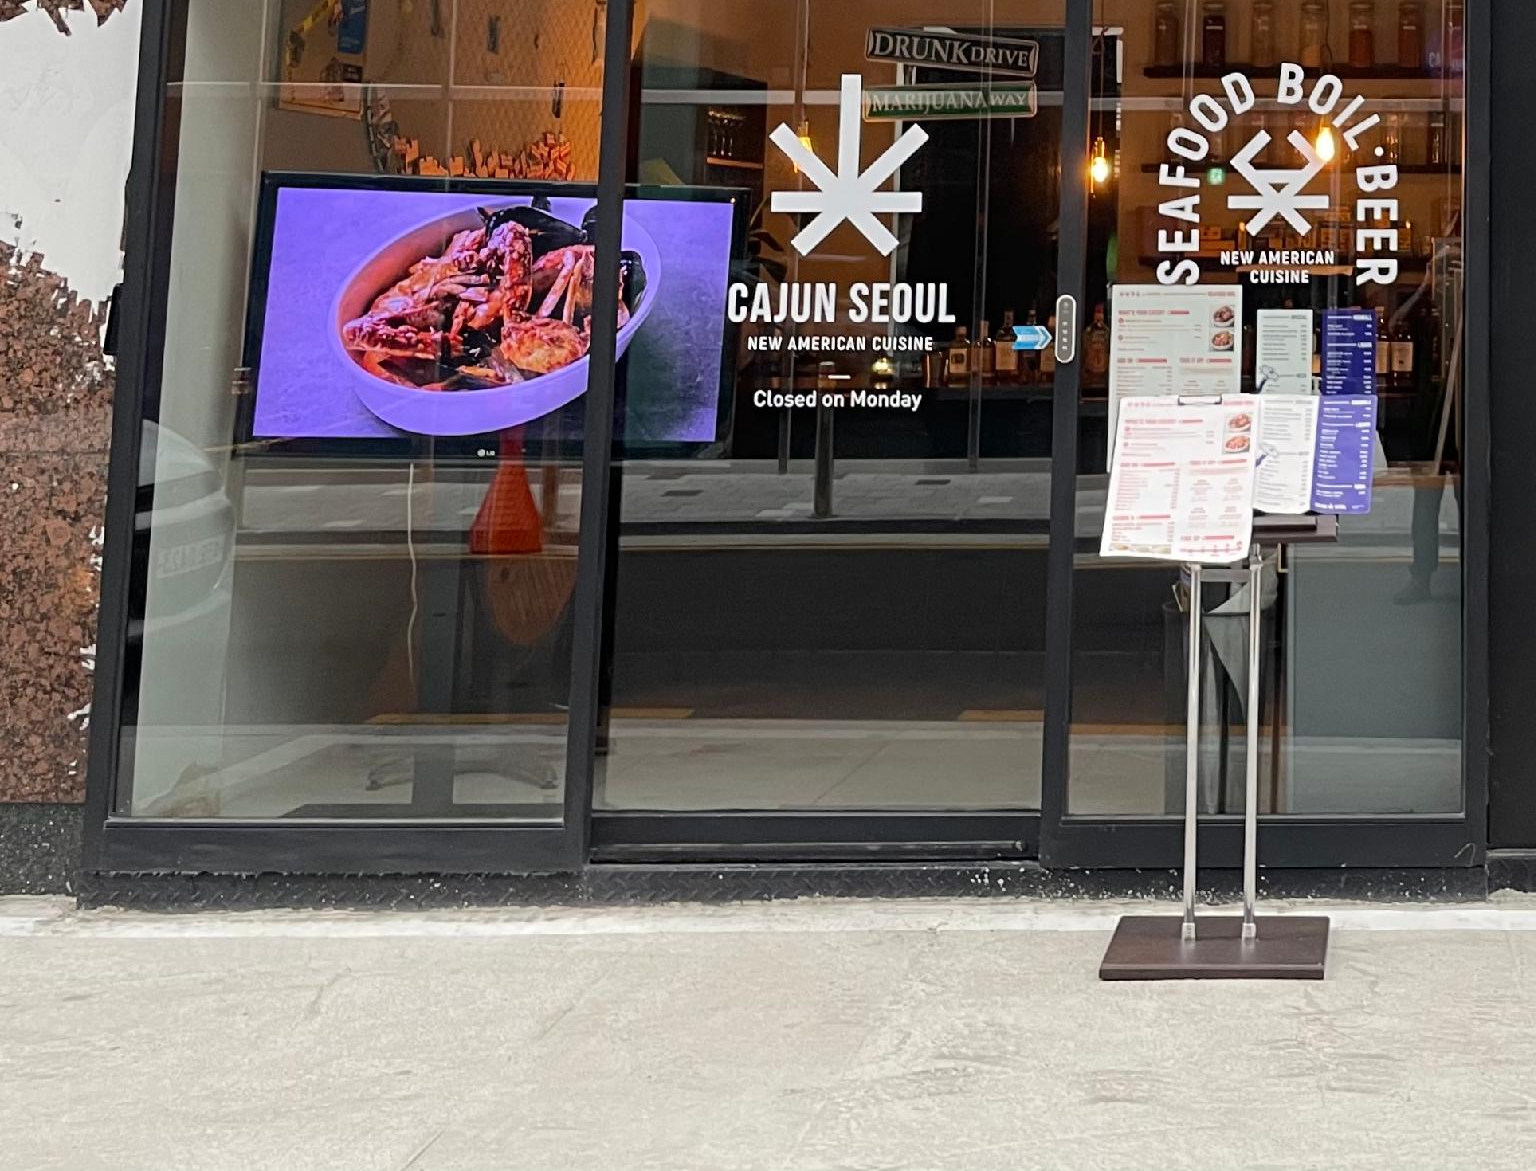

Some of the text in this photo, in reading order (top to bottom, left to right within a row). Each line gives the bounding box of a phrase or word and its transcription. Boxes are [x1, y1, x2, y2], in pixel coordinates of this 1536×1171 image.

[873, 31, 1029, 67] DRUNK DRIVE
[872, 91, 1027, 114] MARIJUANA WAY
[1156, 61, 1398, 287] SEAFOOD BOIL BEER
[1220, 250, 1335, 266] NEW AMERICAN
[1249, 269, 1310, 285] CUISINE
[727, 282, 956, 324] CAJUN SEOUL
[747, 336, 934, 351] NEW AMERICAN CUISINE
[753, 389, 923, 412] Closed on Monday
